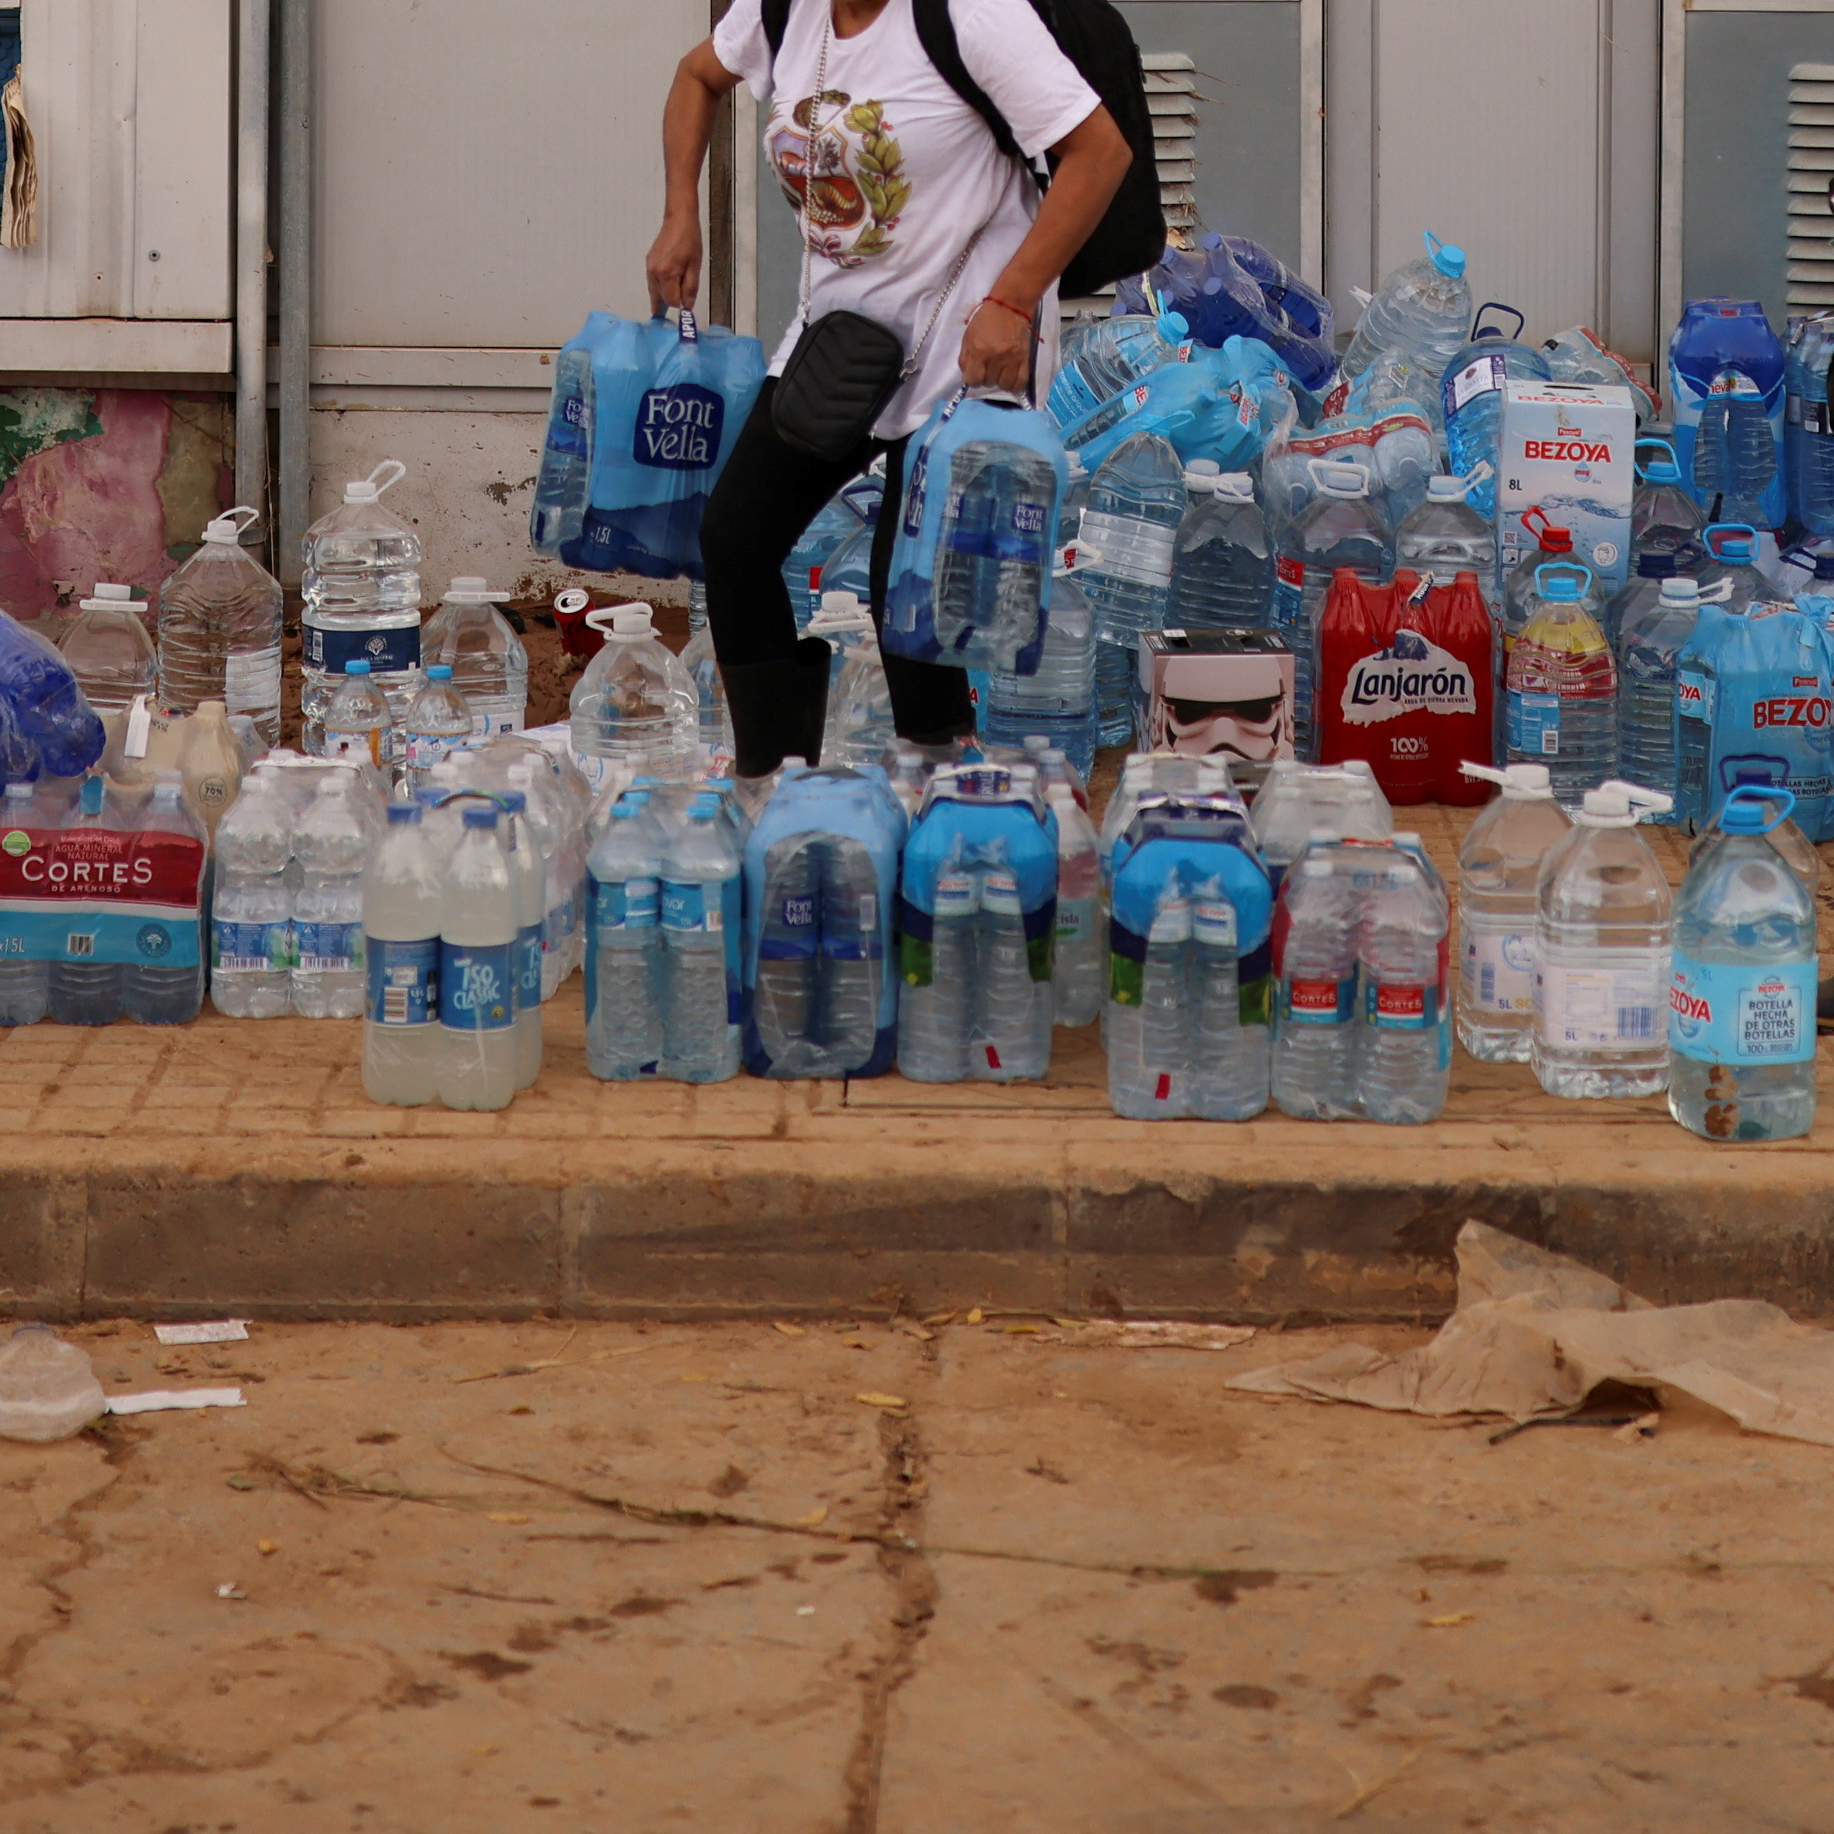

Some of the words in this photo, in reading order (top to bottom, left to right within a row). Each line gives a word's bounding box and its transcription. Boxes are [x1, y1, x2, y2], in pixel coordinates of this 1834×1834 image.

[1517, 396, 1605, 405] BEZOYA
[646, 395, 715, 429] Font
[643, 425, 709, 463] Vella
[1524, 441, 1612, 463] BEZOYA
[1509, 480, 1522, 491] 8L
[1017, 505, 1045, 519] Font
[1015, 518, 1043, 532] Vella
[1351, 667, 1466, 705] Lanjarón
[205, 787, 223, 796] 70%
[55, 845, 82, 853] AGUA
[83, 844, 123, 854] MINERAL
[68, 852, 109, 861] NATURAL
[22, 856, 152, 883] CORTES
[70, 885, 121, 894] ARENOSO
[1292, 993, 1336, 1006] CORTES
[1378, 997, 1423, 1011] CORTES
[1670, 986, 1711, 1023] EZOYA
[1749, 1000, 1793, 1011] BOTELLA
[1754, 1011, 1788, 1020] HECHA
[1746, 1021, 1759, 1030] DE
[1762, 1019, 1795, 1030] OTRAS
[1565, 1031, 1578, 1042] 5L
[1745, 1029, 1795, 1041] BOTELLAS
